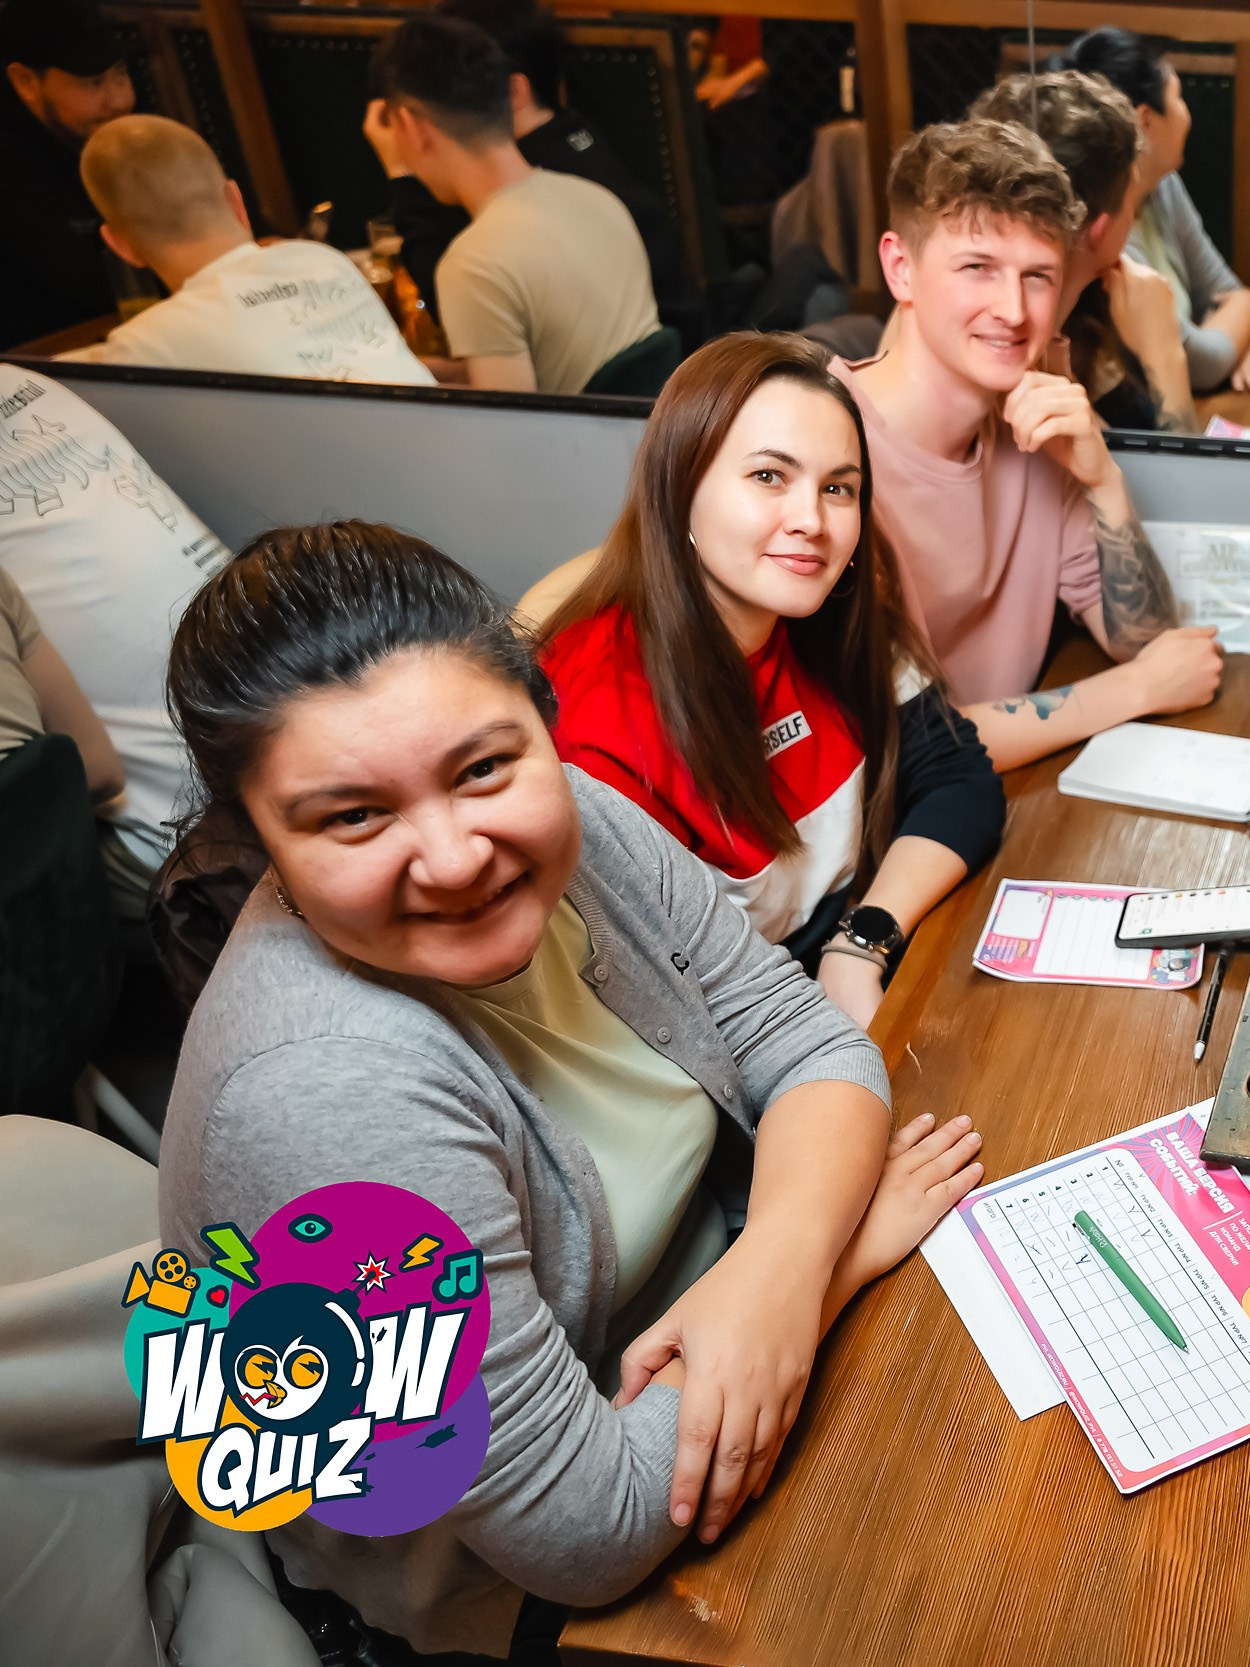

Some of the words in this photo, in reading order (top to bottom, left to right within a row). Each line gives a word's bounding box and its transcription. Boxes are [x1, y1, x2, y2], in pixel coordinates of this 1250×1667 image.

[1166, 1131, 1199, 1171] ВАША
[1193, 1166, 1235, 1214] ВЕРСИЯ
[1220, 1226, 1241, 1252] КОМАНД
[1229, 1222, 1239, 1232] ПО
[1209, 1231, 1223, 1244] ДЛЯ
[1219, 1243, 1240, 1266] СВЕРКИ
